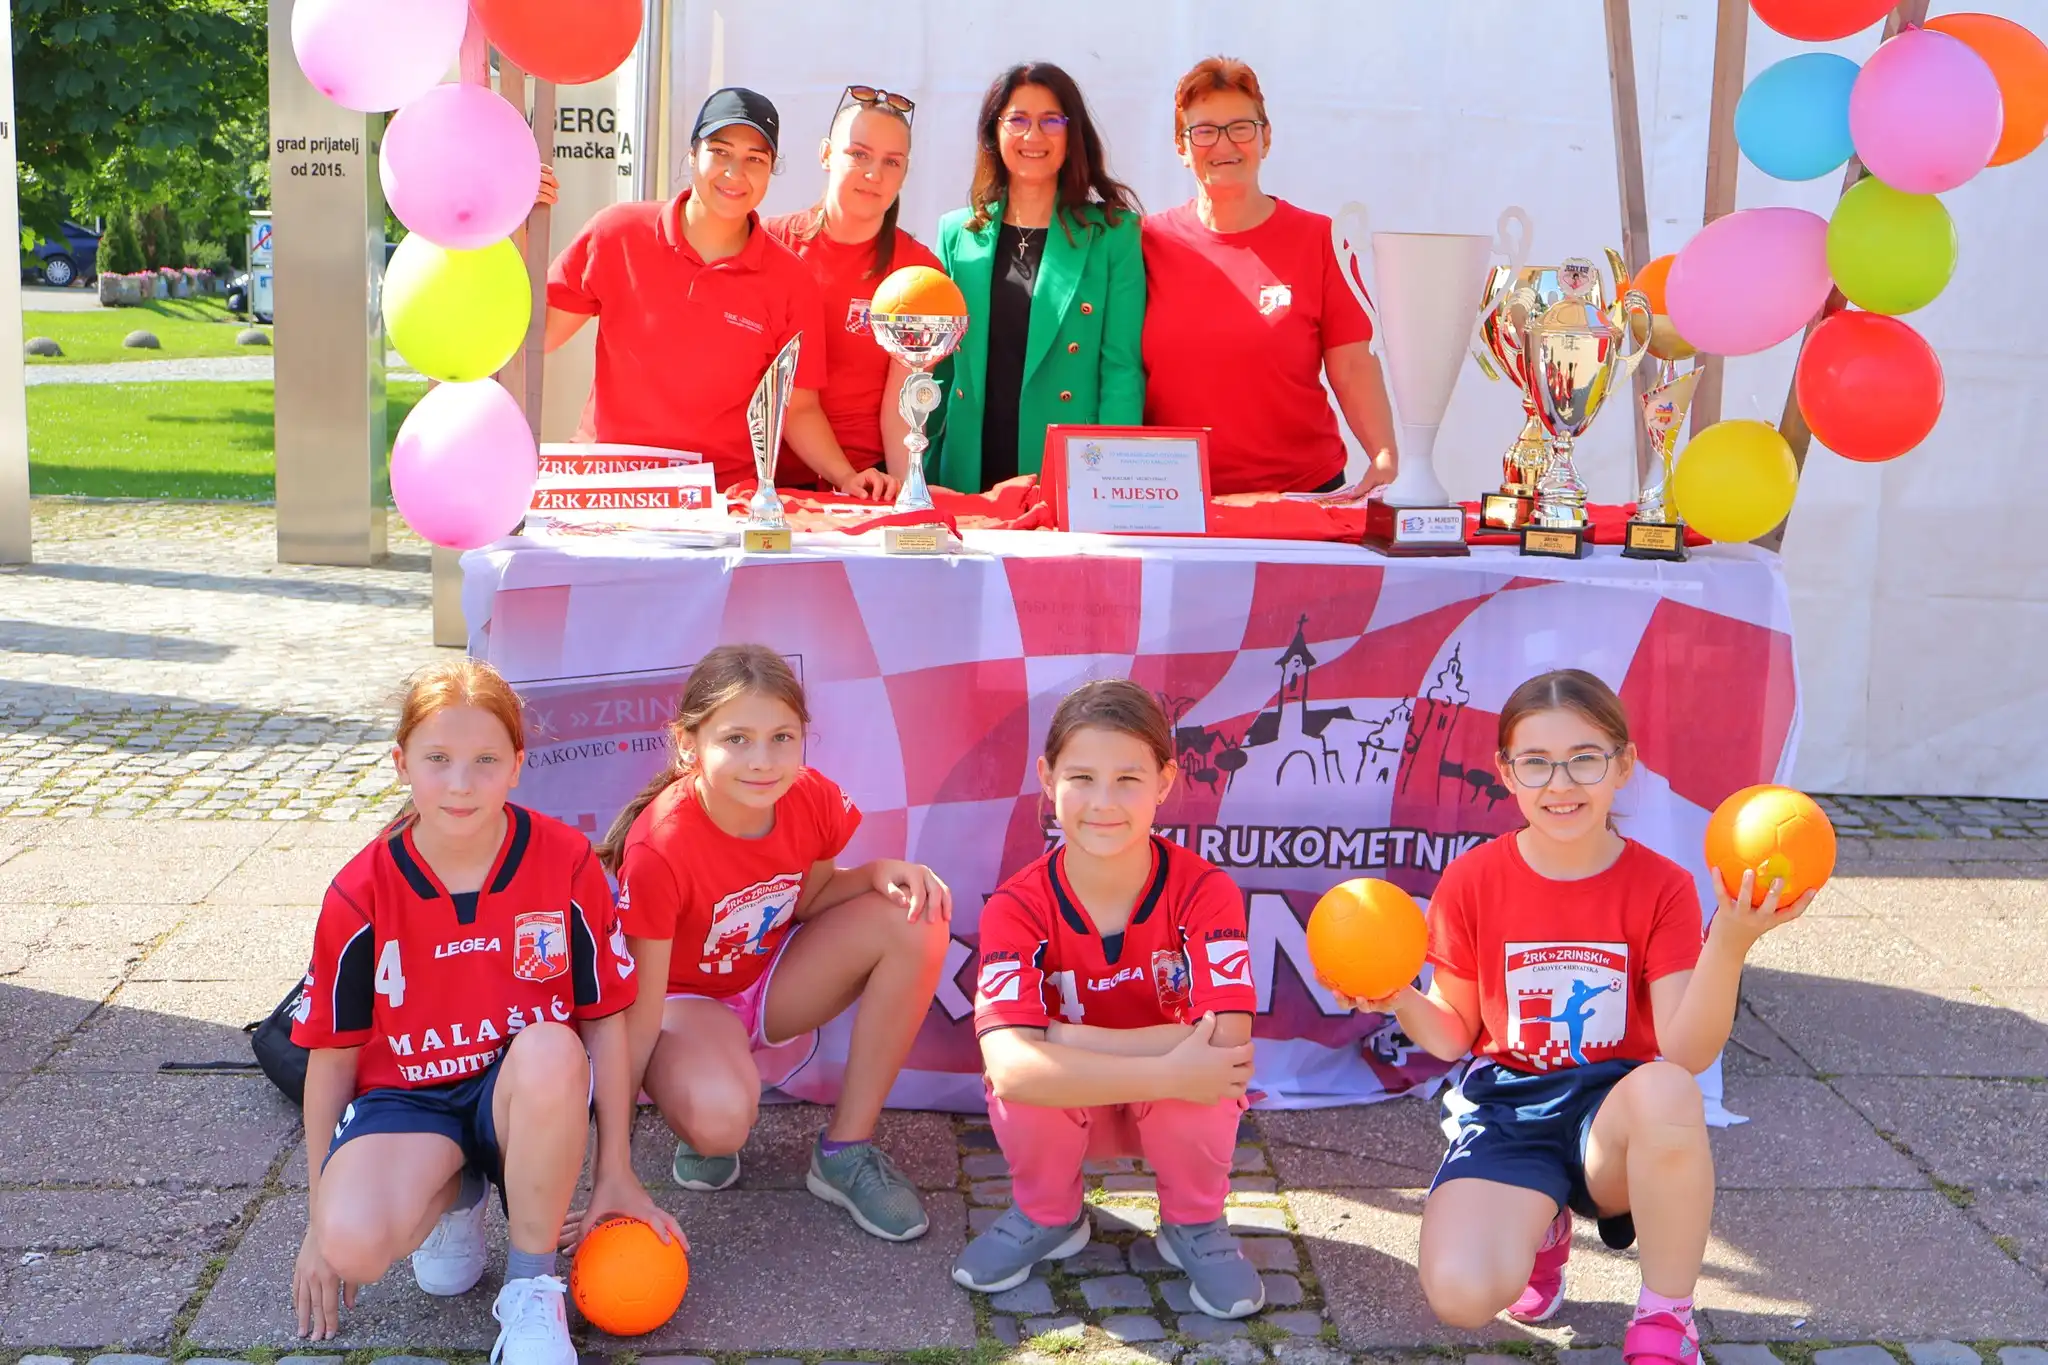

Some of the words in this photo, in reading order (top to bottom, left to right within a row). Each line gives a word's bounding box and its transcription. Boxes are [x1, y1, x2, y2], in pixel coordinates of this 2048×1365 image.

[277, 136, 306, 153] grad
[311, 137, 359, 155] prijatelj
[291, 162, 307, 176] od
[312, 162, 346, 177] 2015.
[539, 456, 577, 475] ŽRK
[538, 491, 581, 508] ŽRK
[586, 492, 669, 508] ZRINSKI
[1092, 487, 1106, 500] 1.
[1112, 487, 1179, 501] MJESTO
[528, 740, 616, 769] ČAKOVEC
[632, 734, 674, 754] HRV
[434, 937, 501, 959] LEGEA
[1522, 951, 1548, 965] ŽRK
[374, 938, 406, 1009] 4
[1087, 966, 1145, 991] LEGEA
[387, 994, 571, 1057] MALAŠIĆ
